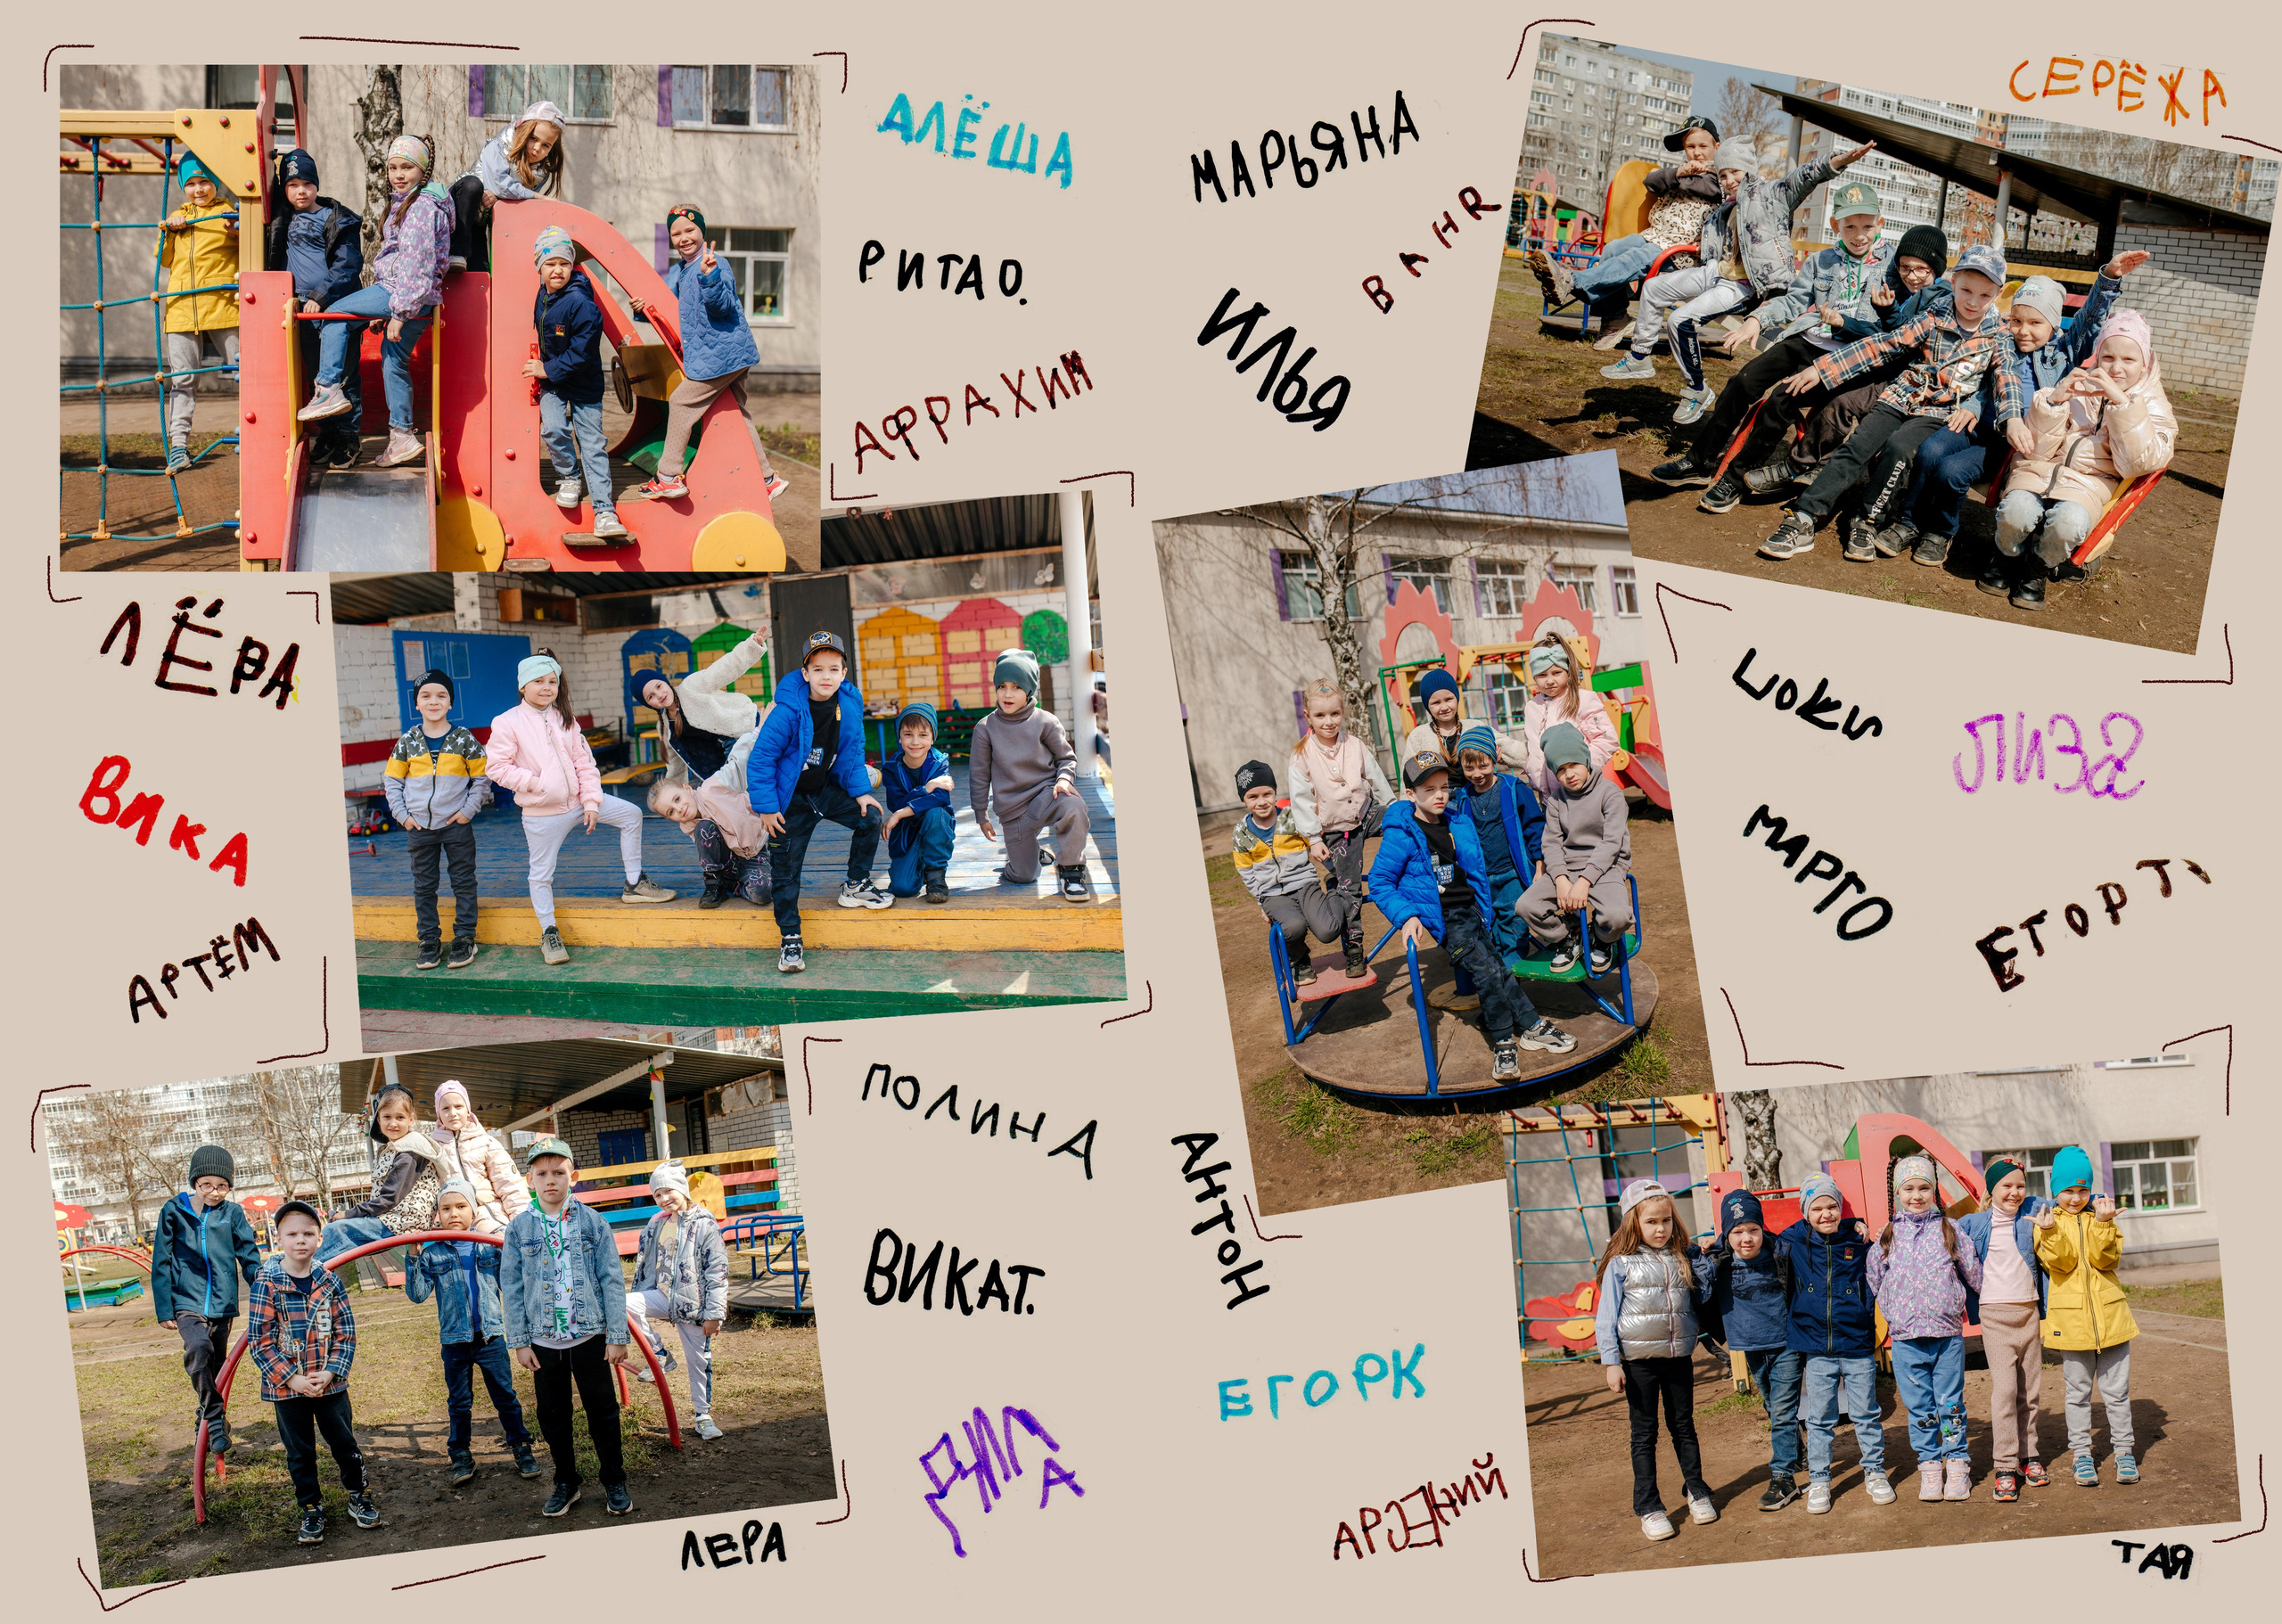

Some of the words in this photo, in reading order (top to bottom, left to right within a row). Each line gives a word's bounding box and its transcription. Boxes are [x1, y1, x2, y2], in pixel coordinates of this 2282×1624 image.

[876, 93, 1073, 190] АЛЁША
[1191, 90, 1420, 204] МАРЬЯНА
[2009, 57, 2227, 127] СЕРЁЖА
[1197, 288, 1351, 433] ИЛЬЯ
[1887, 460, 1906, 488] CLUB
[100, 595, 300, 711] ЛЁРА
[1954, 712, 2146, 801] ЛИЗА
[78, 755, 249, 888] ВИКА
[1743, 804, 1894, 942] МАРГО
[128, 916, 282, 1024] АРТЁМ
[862, 1063, 1098, 1181] ПОЛИНА
[1171, 1132, 1270, 1311] АНТОН
[681, 1520, 788, 1571] ЛЕРА
[2112, 1539, 2195, 1580] ТАЯ
